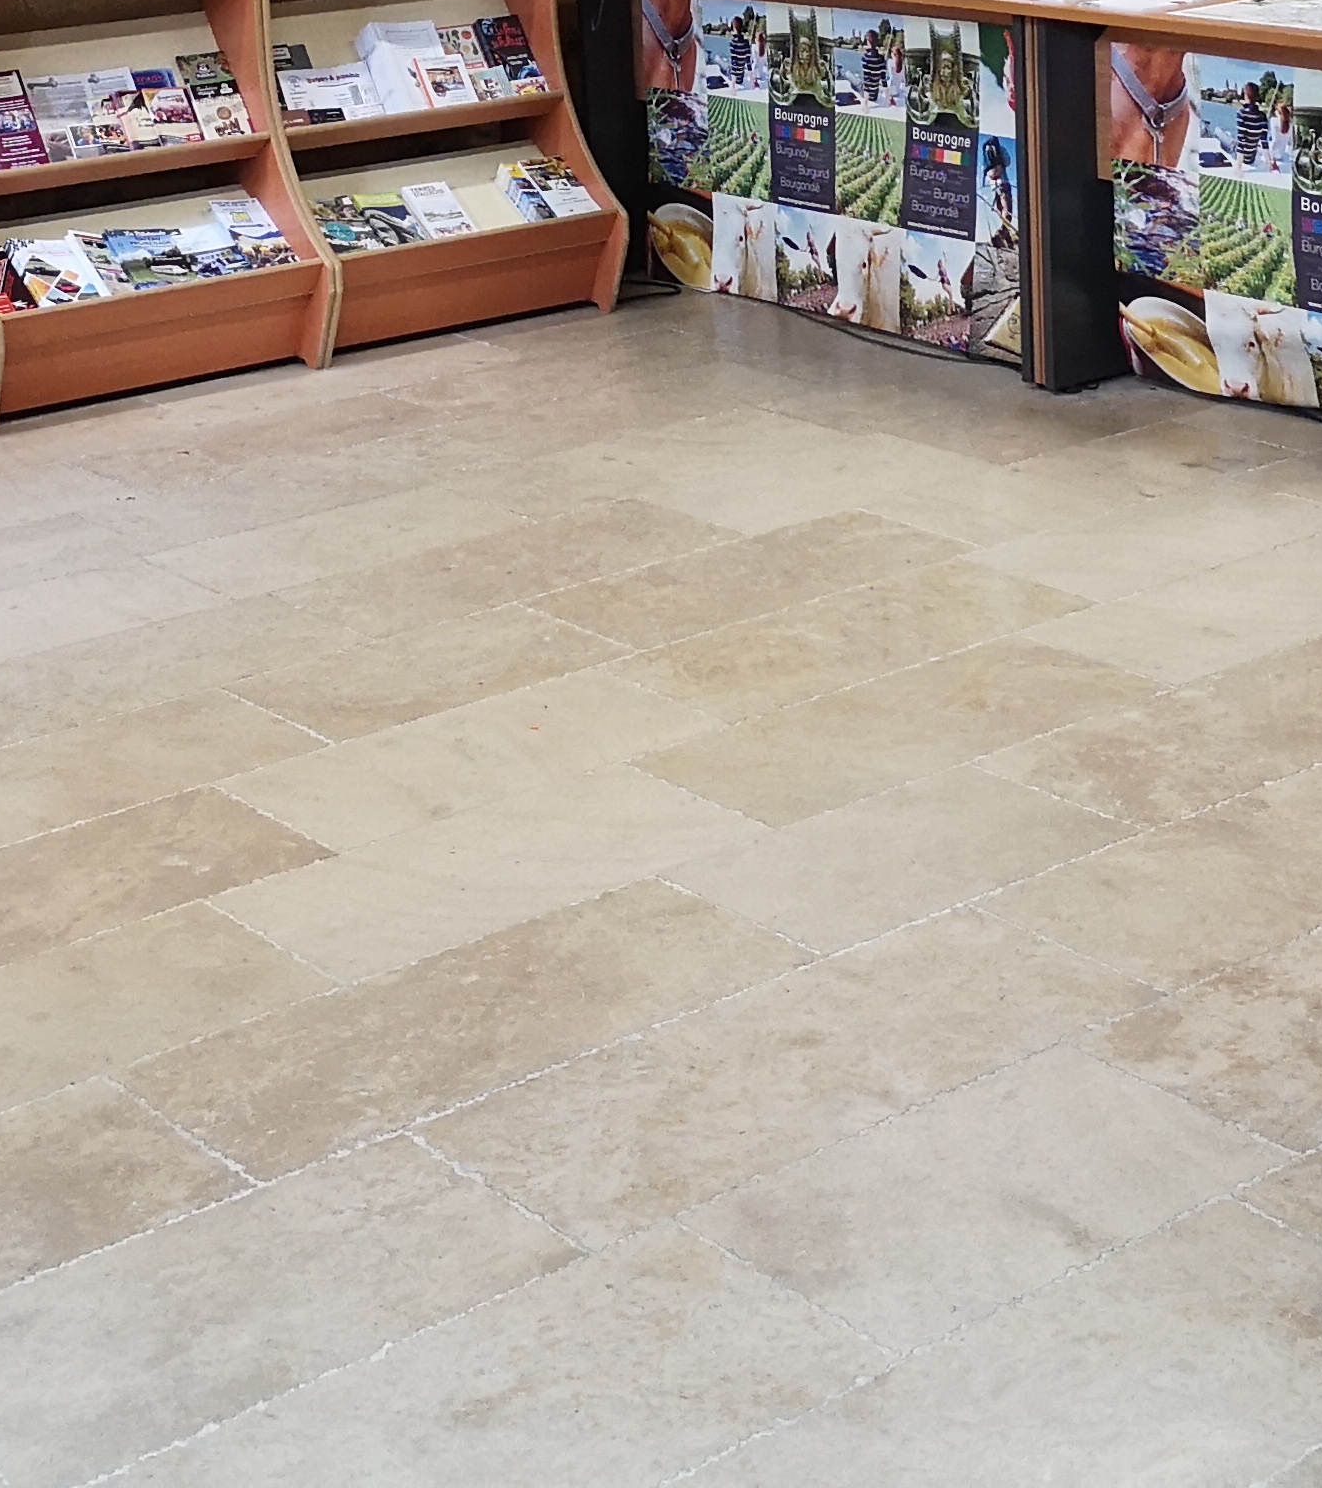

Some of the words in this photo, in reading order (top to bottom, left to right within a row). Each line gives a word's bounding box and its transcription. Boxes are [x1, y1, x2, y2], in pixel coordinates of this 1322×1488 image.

[774, 107, 829, 128] Bourgogne
[912, 126, 972, 149] Bourgogne
[909, 164, 947, 183] Burgundy
[933, 187, 970, 205] Burgund
